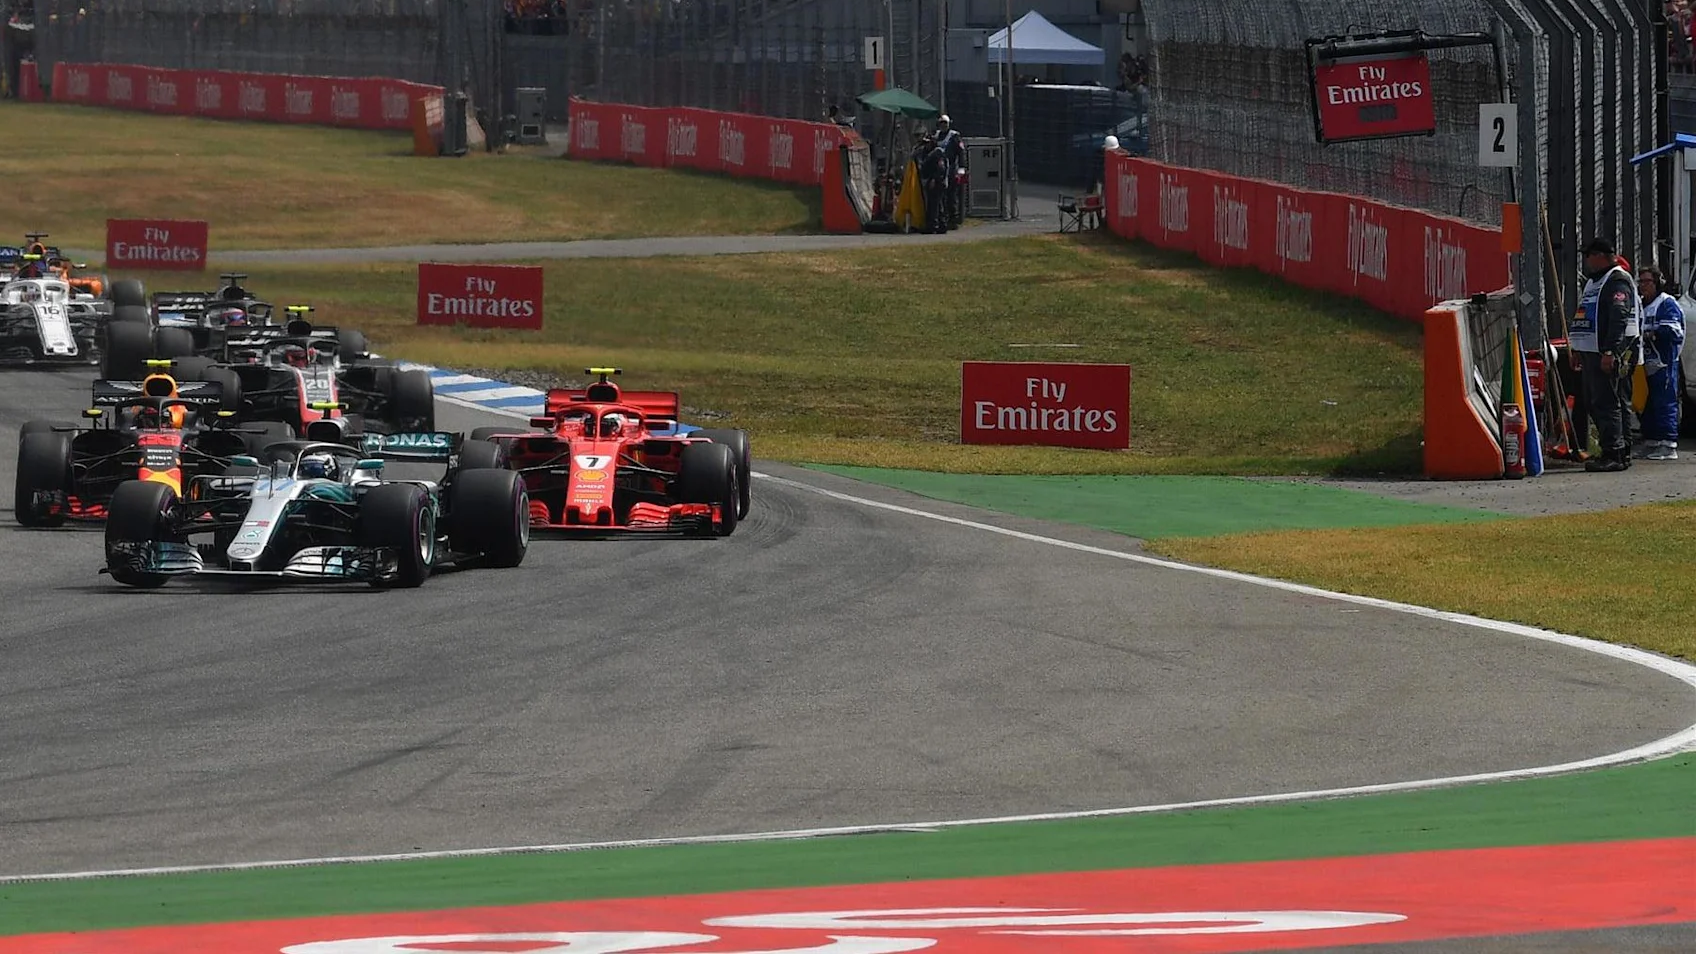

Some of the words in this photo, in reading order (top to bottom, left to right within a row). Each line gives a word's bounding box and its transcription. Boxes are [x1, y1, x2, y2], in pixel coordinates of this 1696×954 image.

[872, 40, 878, 65] 1
[1358, 65, 1386, 81] Fly
[1327, 81, 1422, 105] Emirates
[1493, 117, 1505, 153] 2
[144, 227, 170, 244] Fly
[114, 241, 200, 261] Emirates
[465, 276, 496, 295] Fly
[427, 293, 534, 317] Emirates
[305, 378, 329, 390] 20
[1026, 377, 1067, 403] Fly
[975, 401, 1117, 433] Emirates
[367, 432, 446, 447] RONAS
[585, 457, 599, 468] 7
